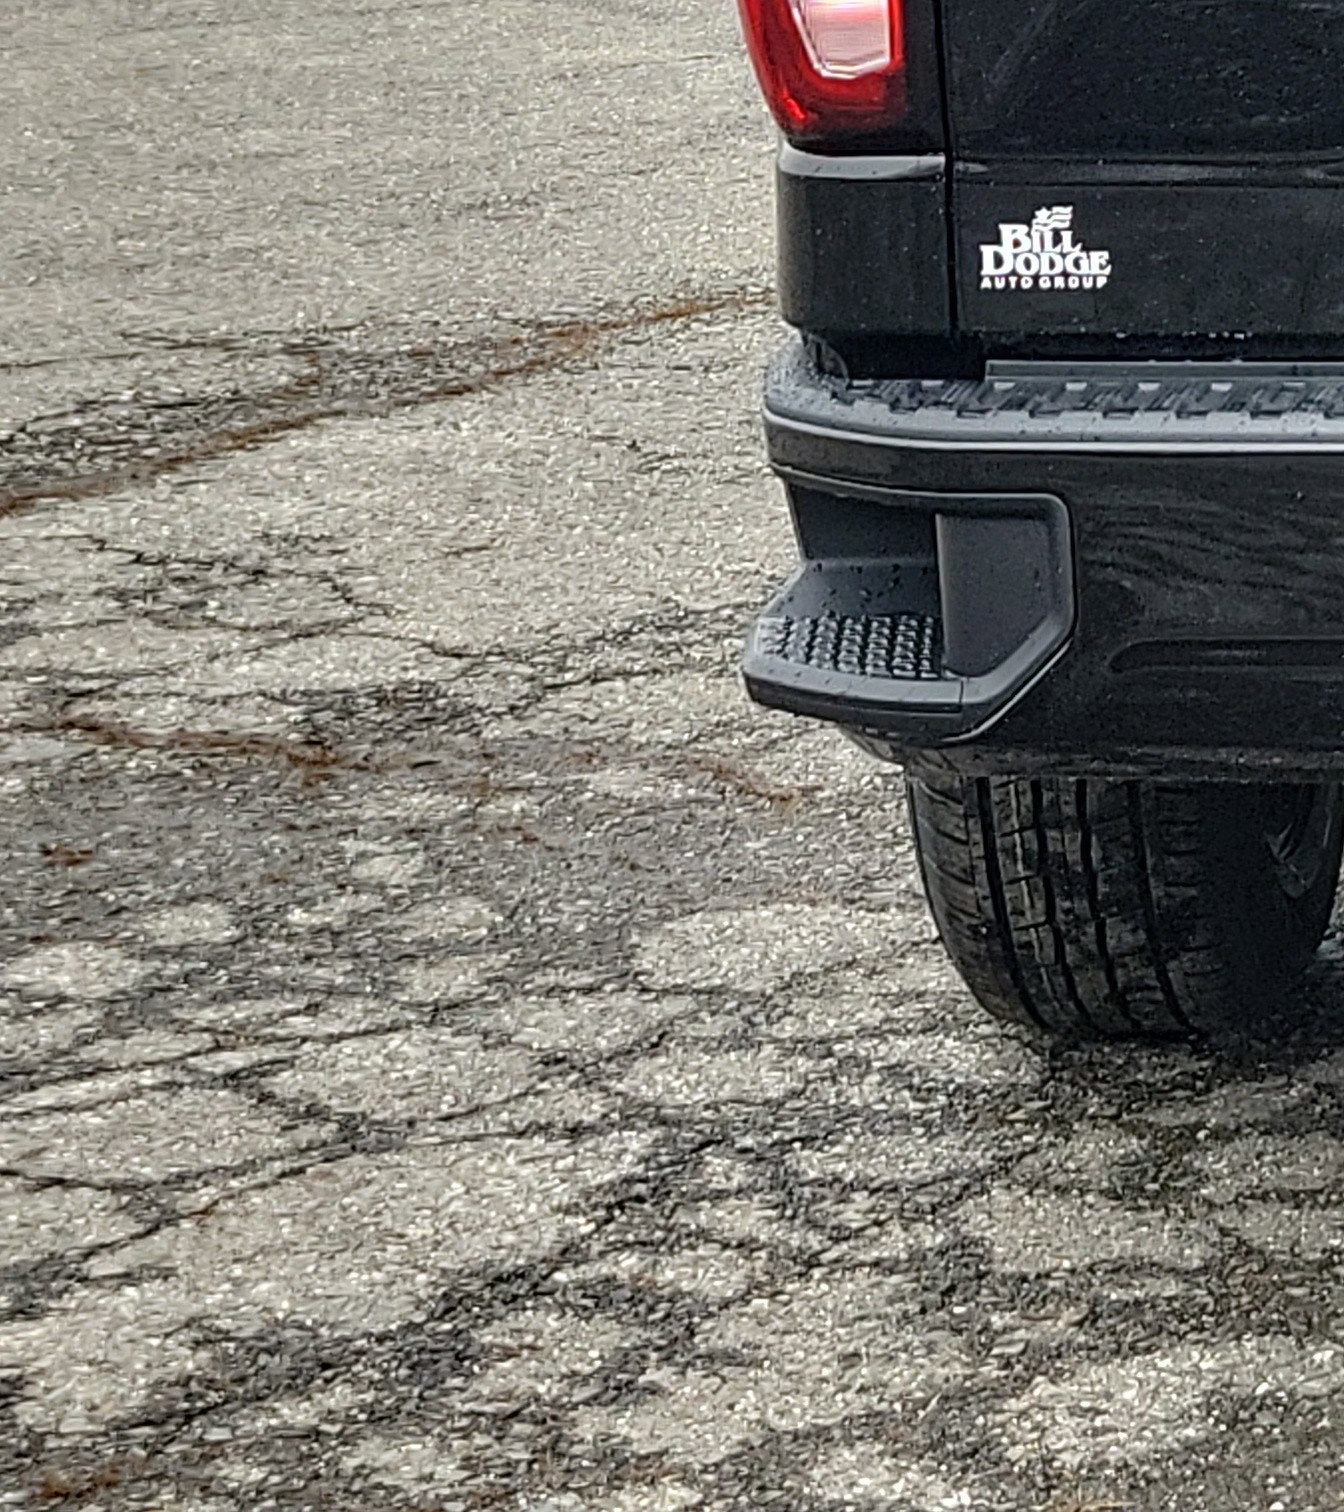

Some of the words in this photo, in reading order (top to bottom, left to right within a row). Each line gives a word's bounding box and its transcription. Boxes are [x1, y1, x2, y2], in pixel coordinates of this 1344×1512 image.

[998, 223, 1083, 254] BILL
[979, 244, 1112, 276] DODGE
[980, 276, 1034, 289] AUTO
[1038, 276, 1109, 289] GROUP
